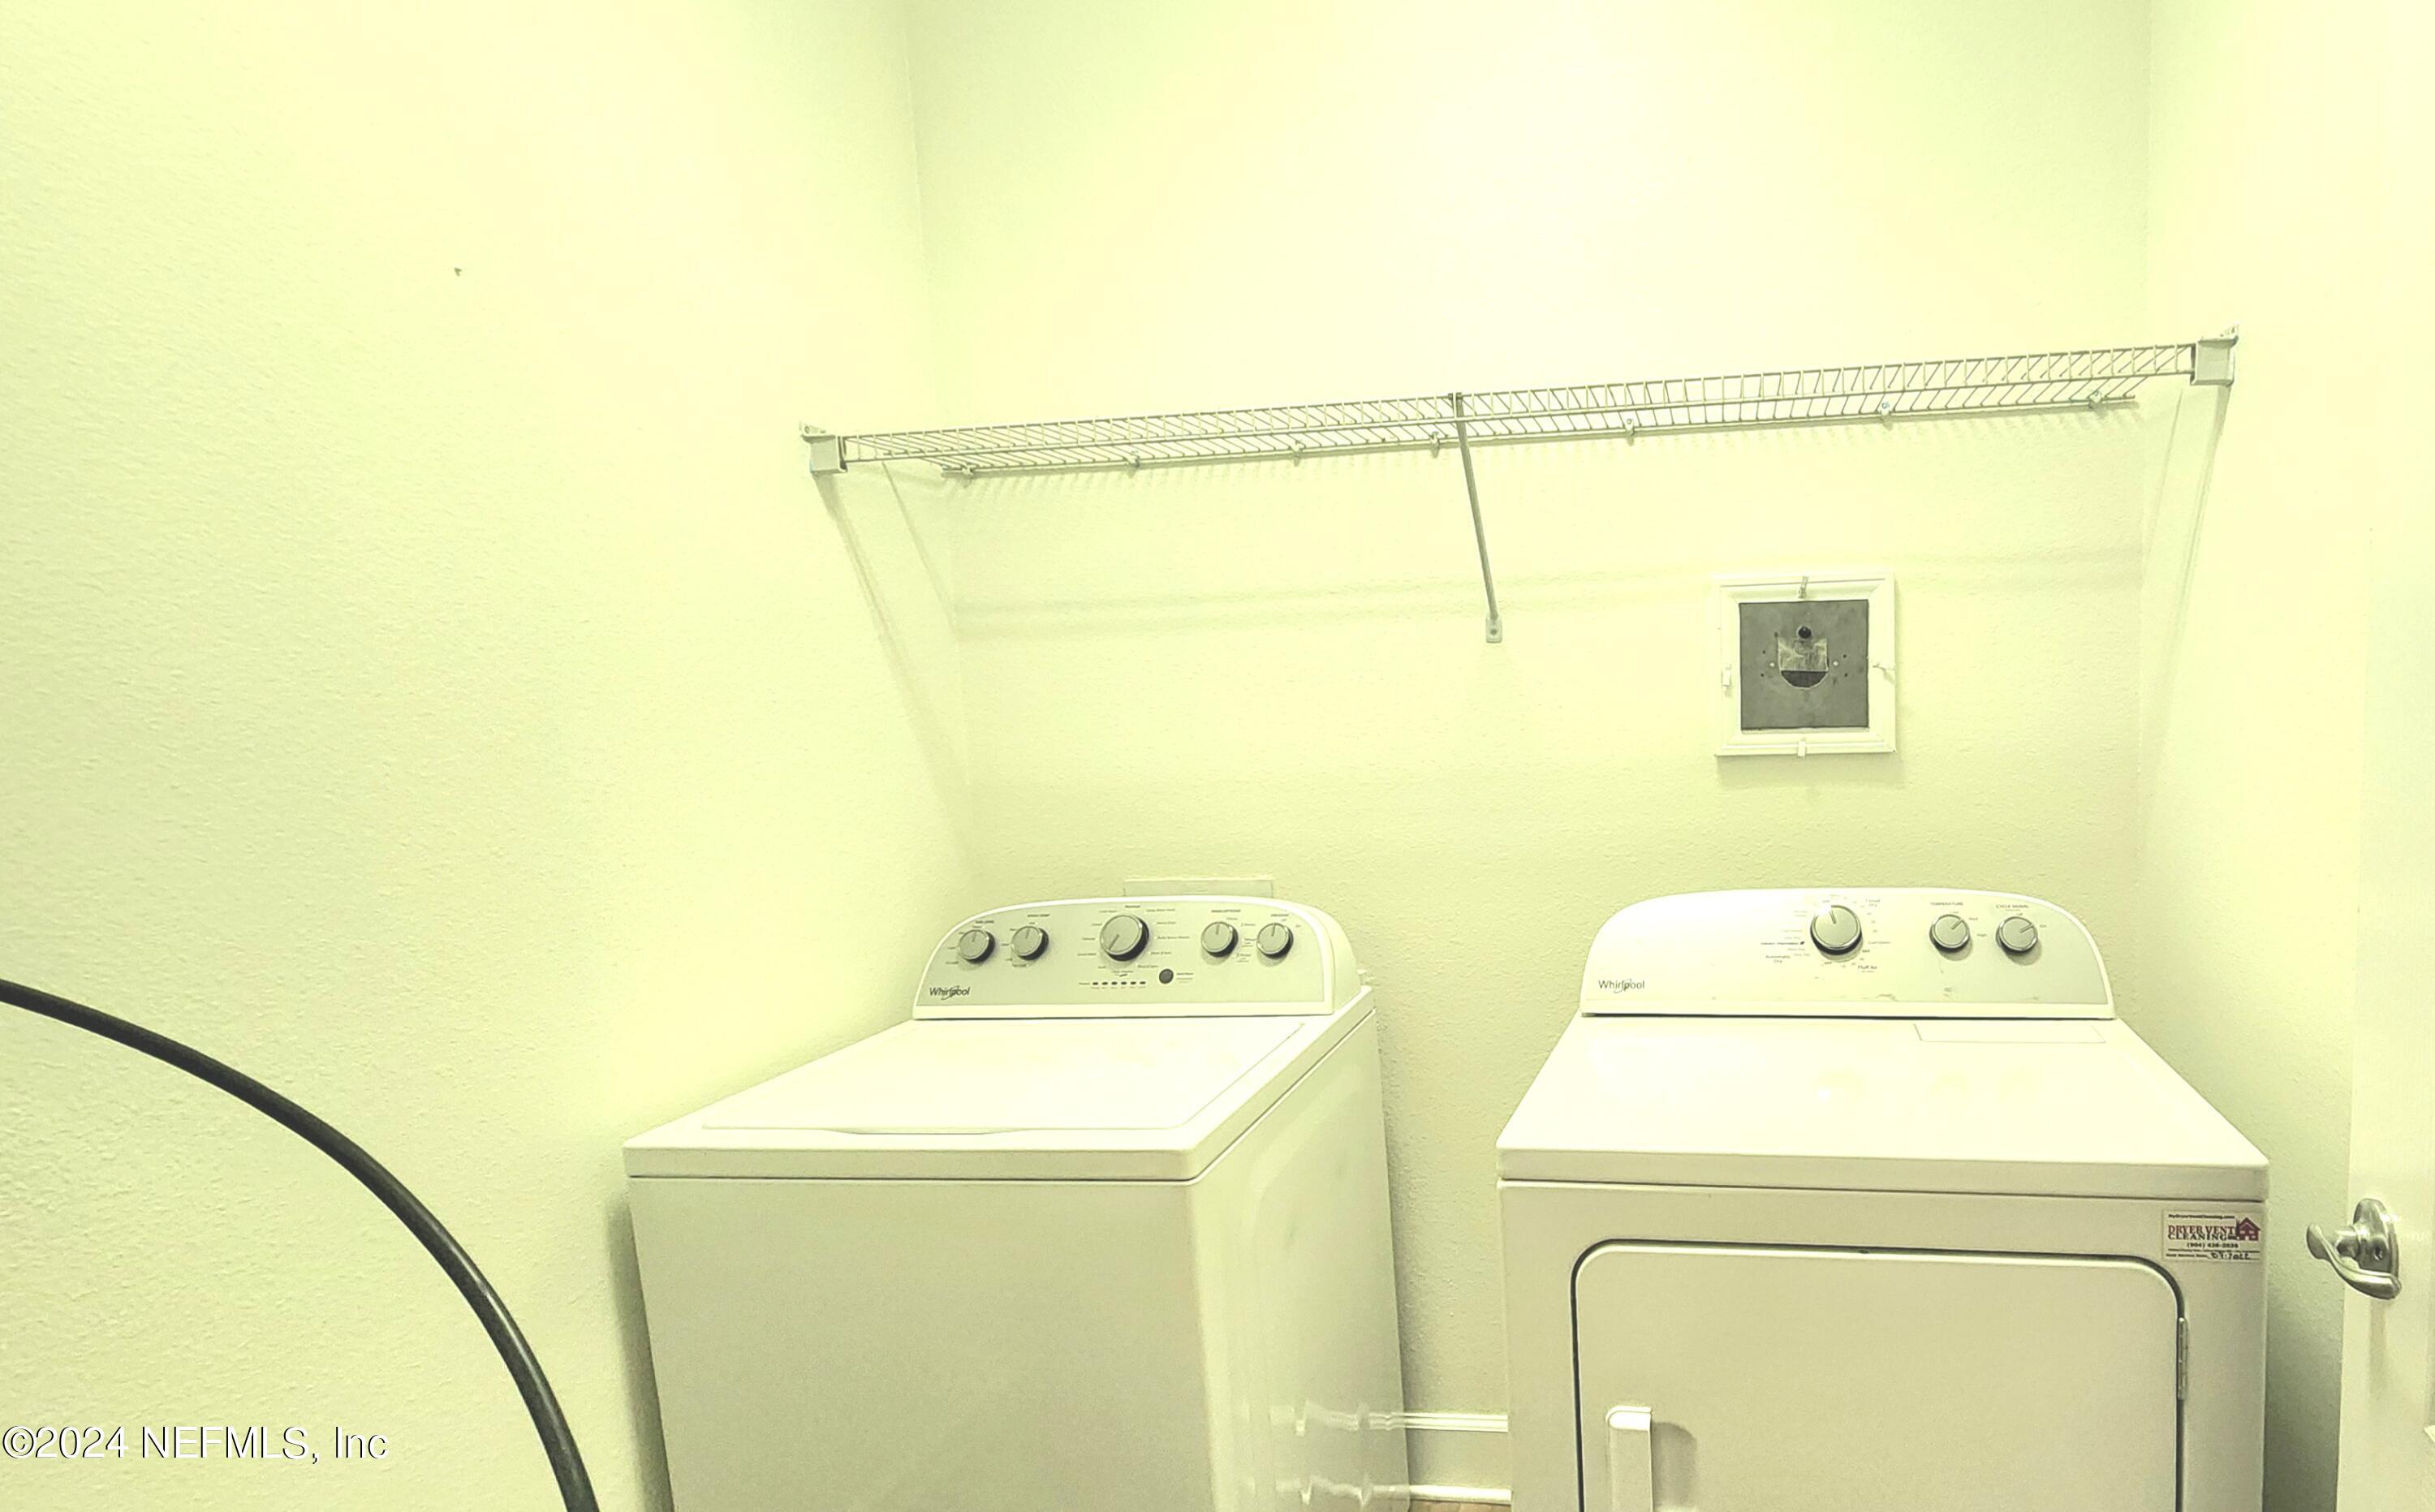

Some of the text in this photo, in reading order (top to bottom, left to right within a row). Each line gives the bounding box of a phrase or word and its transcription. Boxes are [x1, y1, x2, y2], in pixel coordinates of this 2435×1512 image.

[929, 985, 971, 1000] Whirlpool
[1598, 978, 1645, 993] Whirlpool
[2168, 1225, 2235, 1235] DRYER VENT
